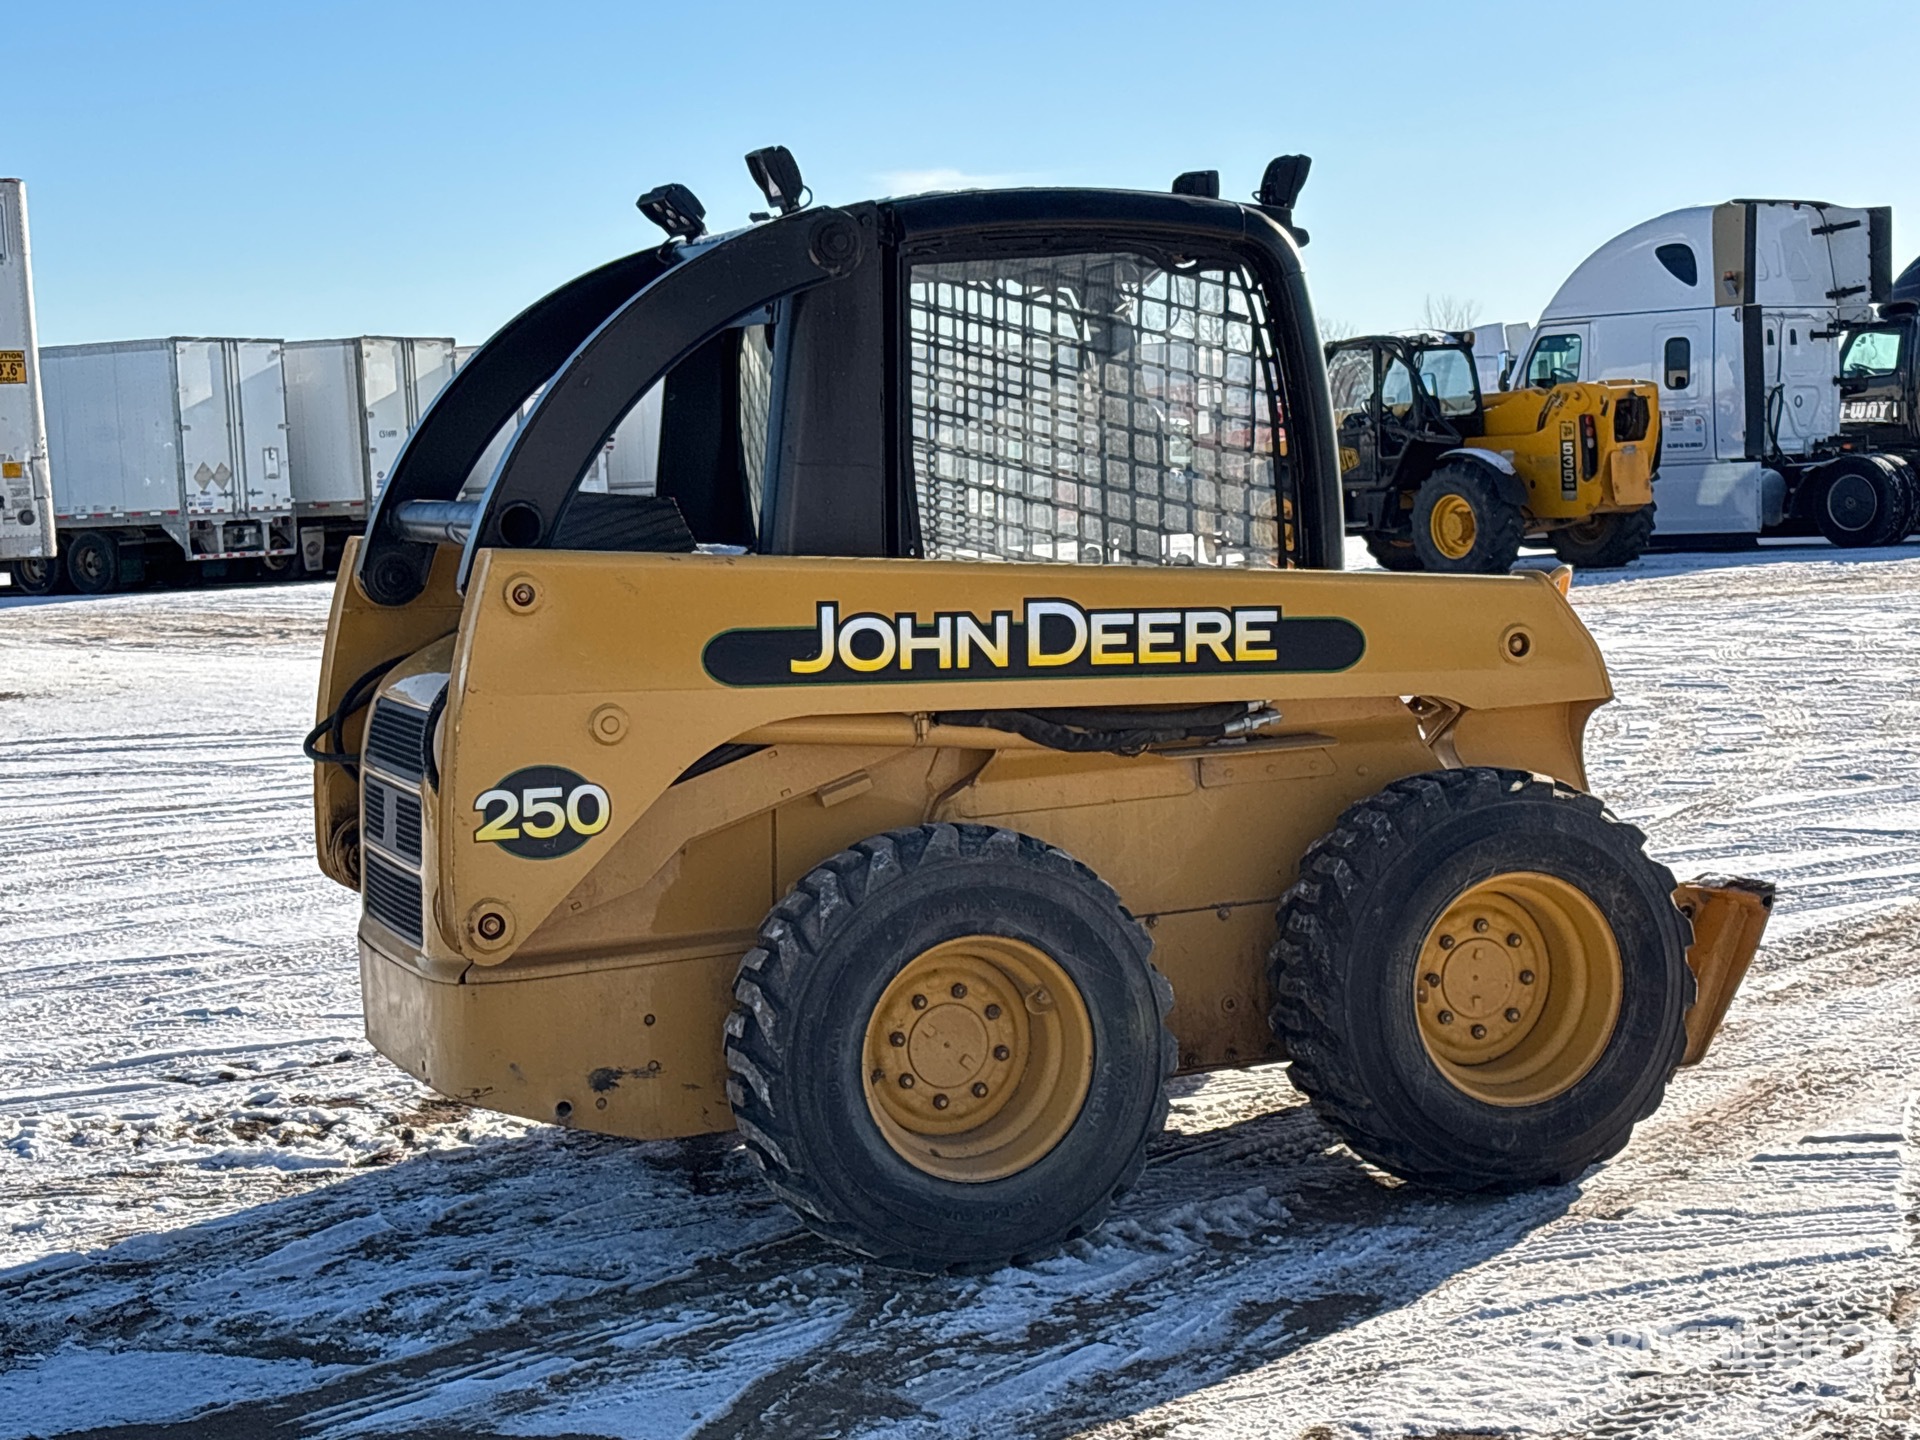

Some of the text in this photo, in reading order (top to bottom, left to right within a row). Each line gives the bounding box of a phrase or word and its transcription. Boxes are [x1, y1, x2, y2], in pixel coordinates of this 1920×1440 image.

[1562, 441, 1575, 482] 535
[790, 602, 1278, 674] JOHN DEERE
[474, 783, 611, 842] 250
